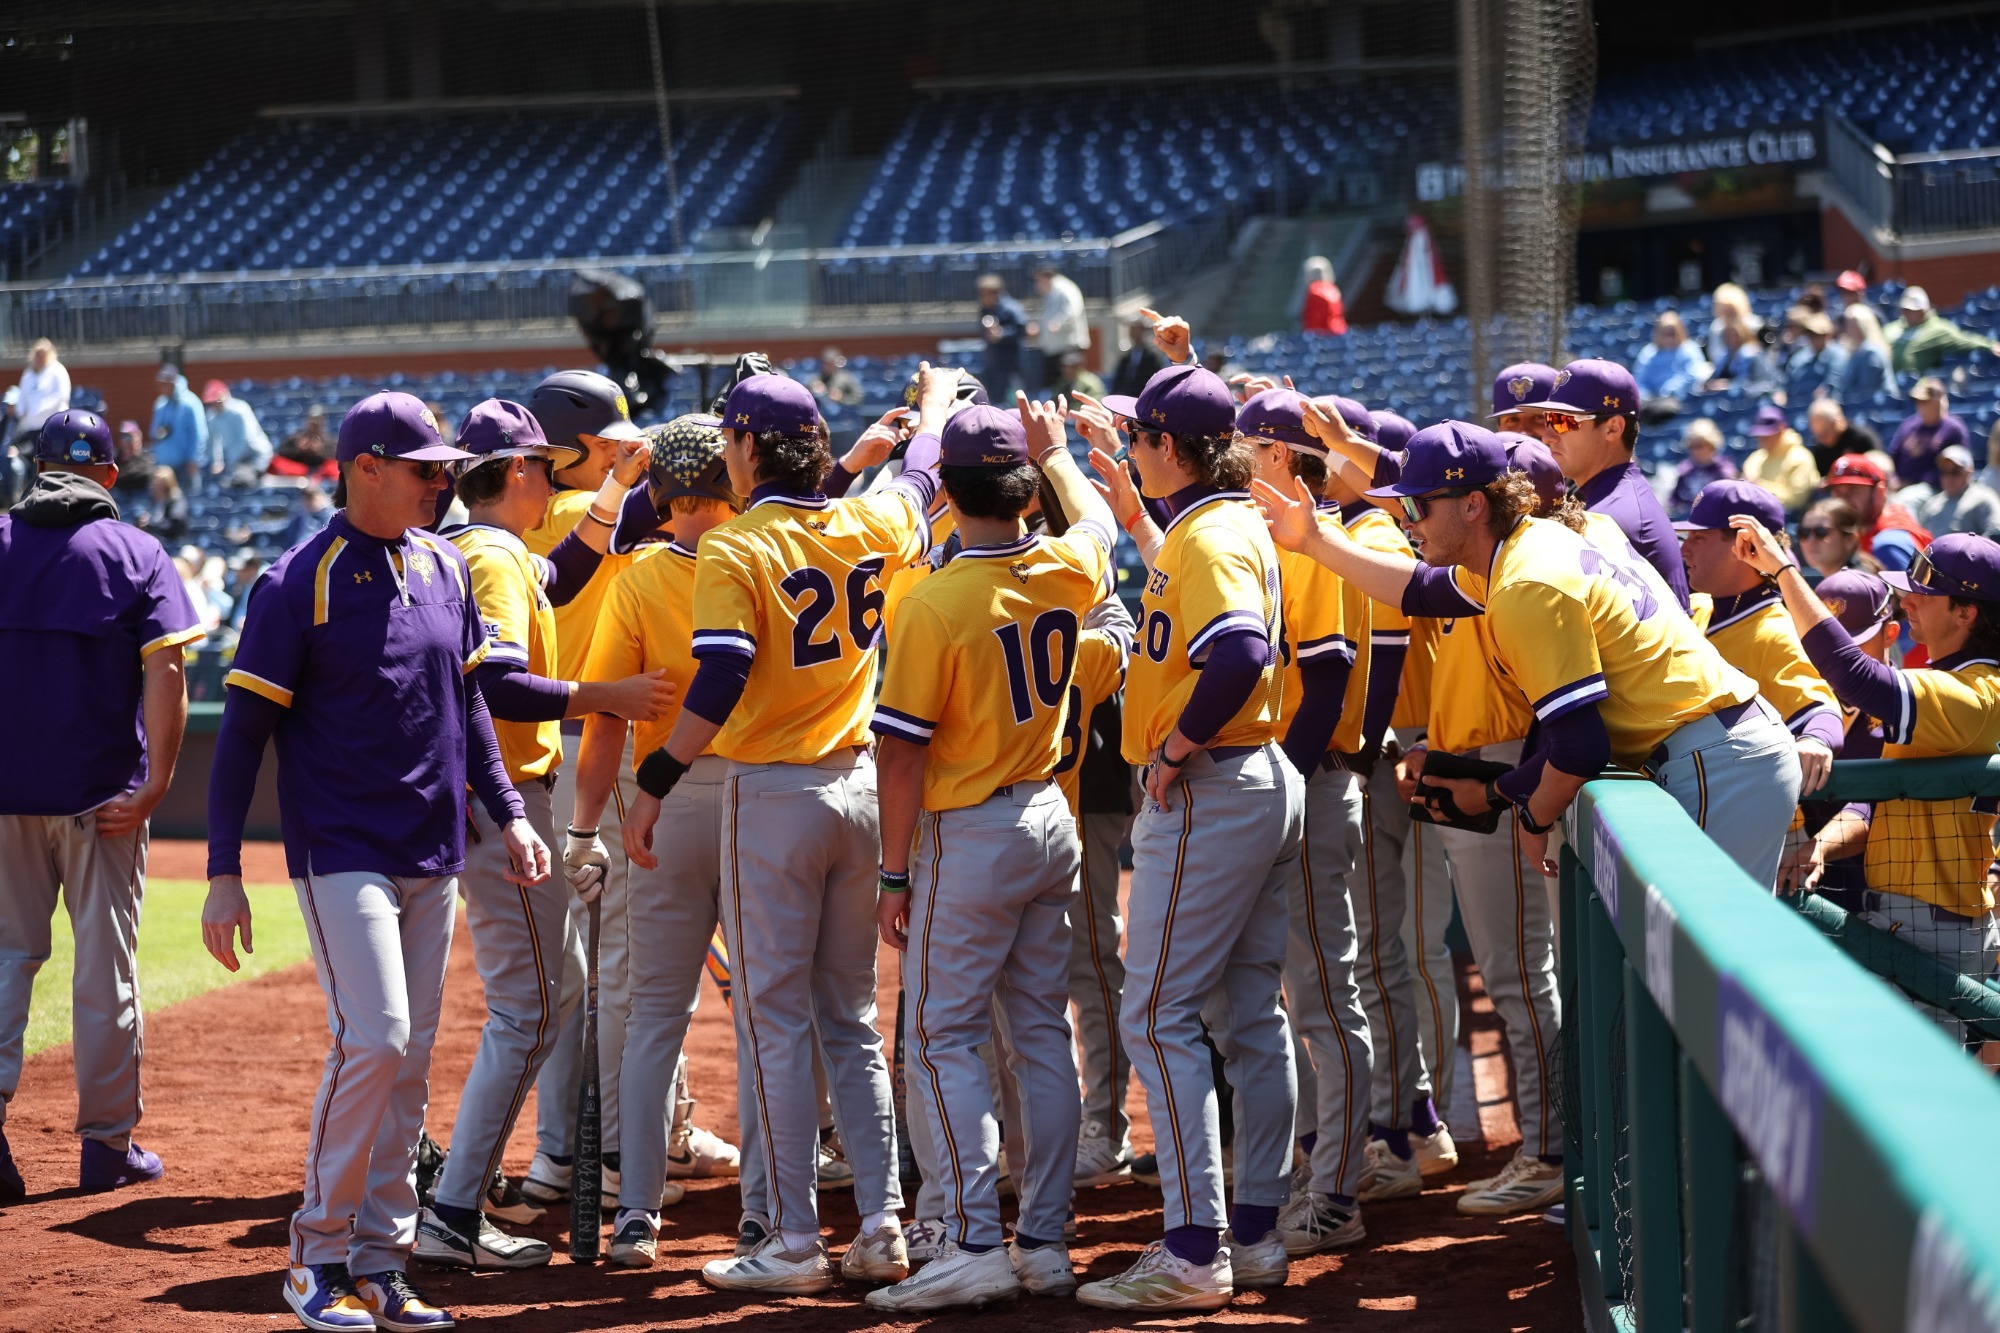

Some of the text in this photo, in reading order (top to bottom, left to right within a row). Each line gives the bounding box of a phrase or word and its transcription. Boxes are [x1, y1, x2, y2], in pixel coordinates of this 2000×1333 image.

[1747, 128, 1817, 165] CLUB
[72, 449, 92, 458] NCAA
[981, 453, 1012, 464] WCU
[779, 556, 887, 670] 26
[991, 607, 1080, 726] 10
[577, 1123, 600, 1243] DEMARINI
